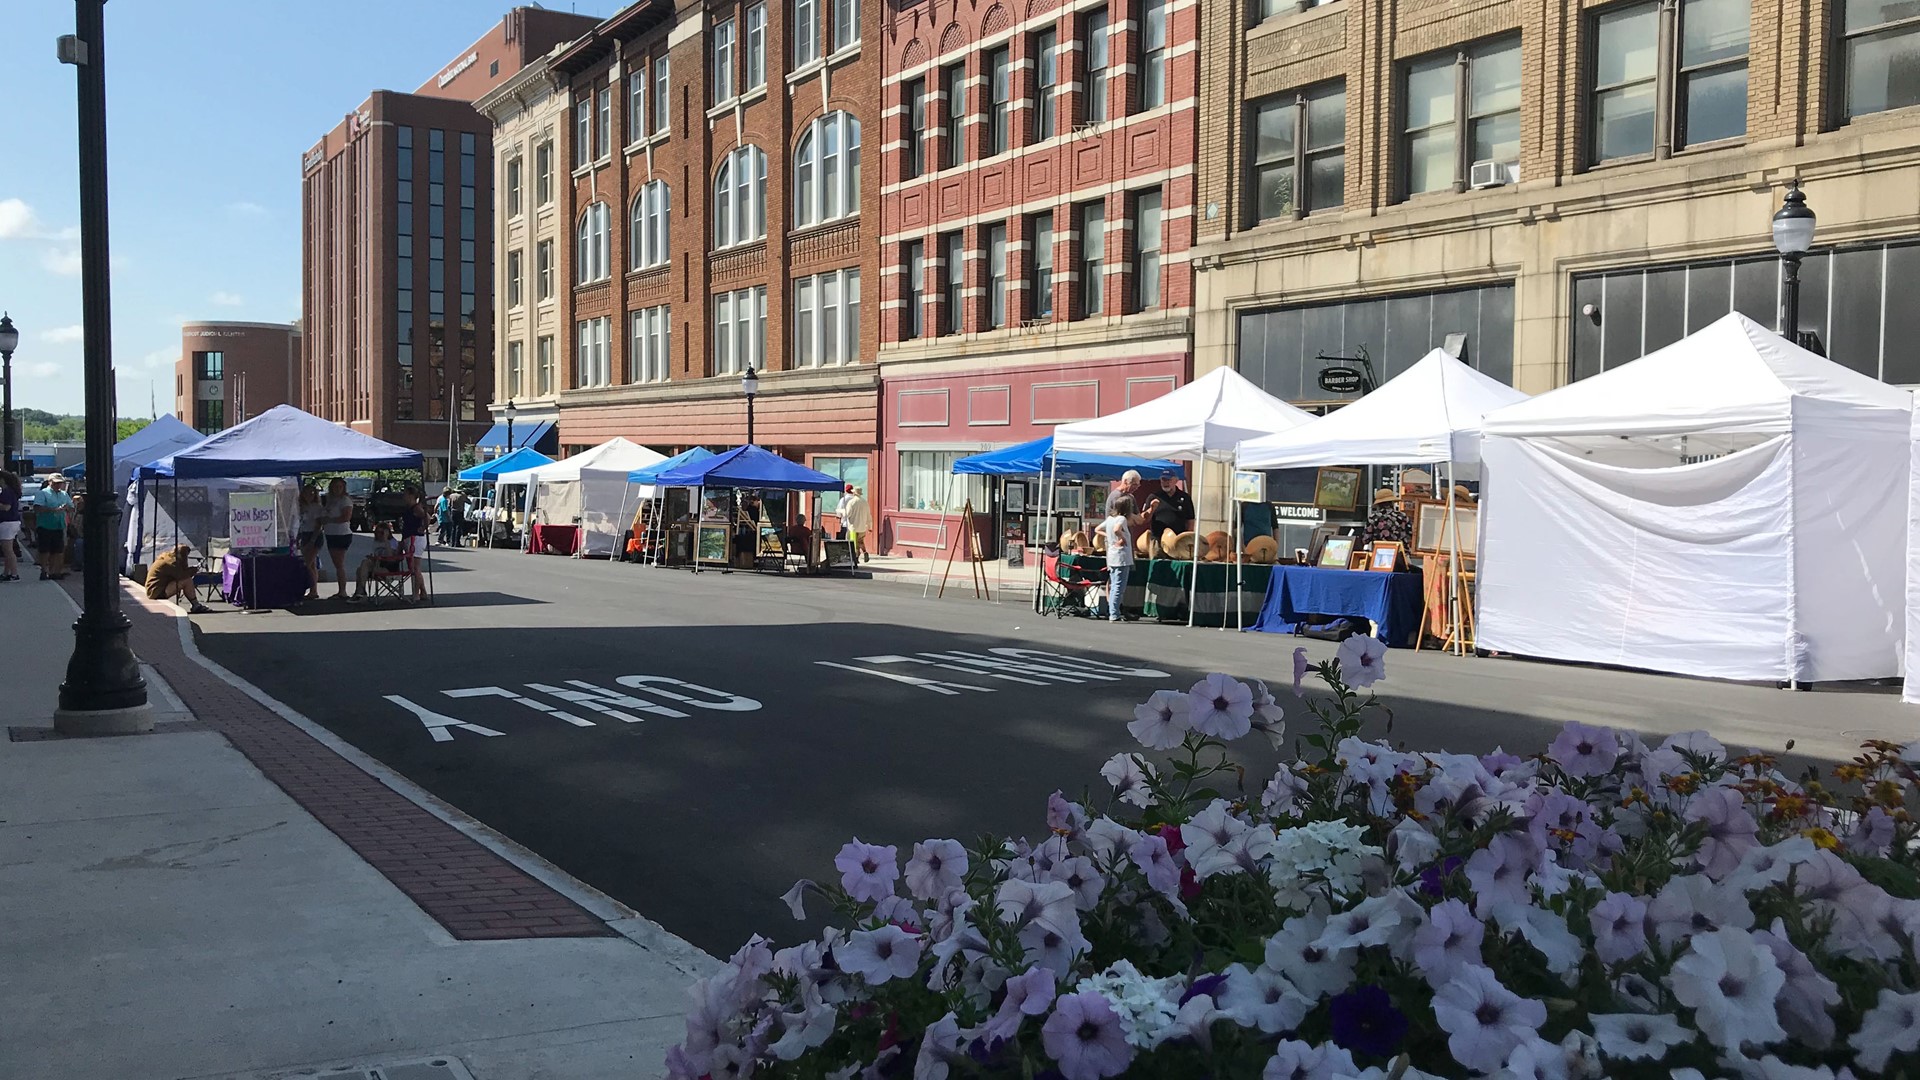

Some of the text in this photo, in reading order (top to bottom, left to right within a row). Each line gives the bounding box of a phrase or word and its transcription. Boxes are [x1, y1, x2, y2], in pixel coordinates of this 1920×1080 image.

[231, 508, 251, 522] JOHN
[1280, 506, 1320, 518] WELCOME
[382, 674, 763, 742] ONLY
